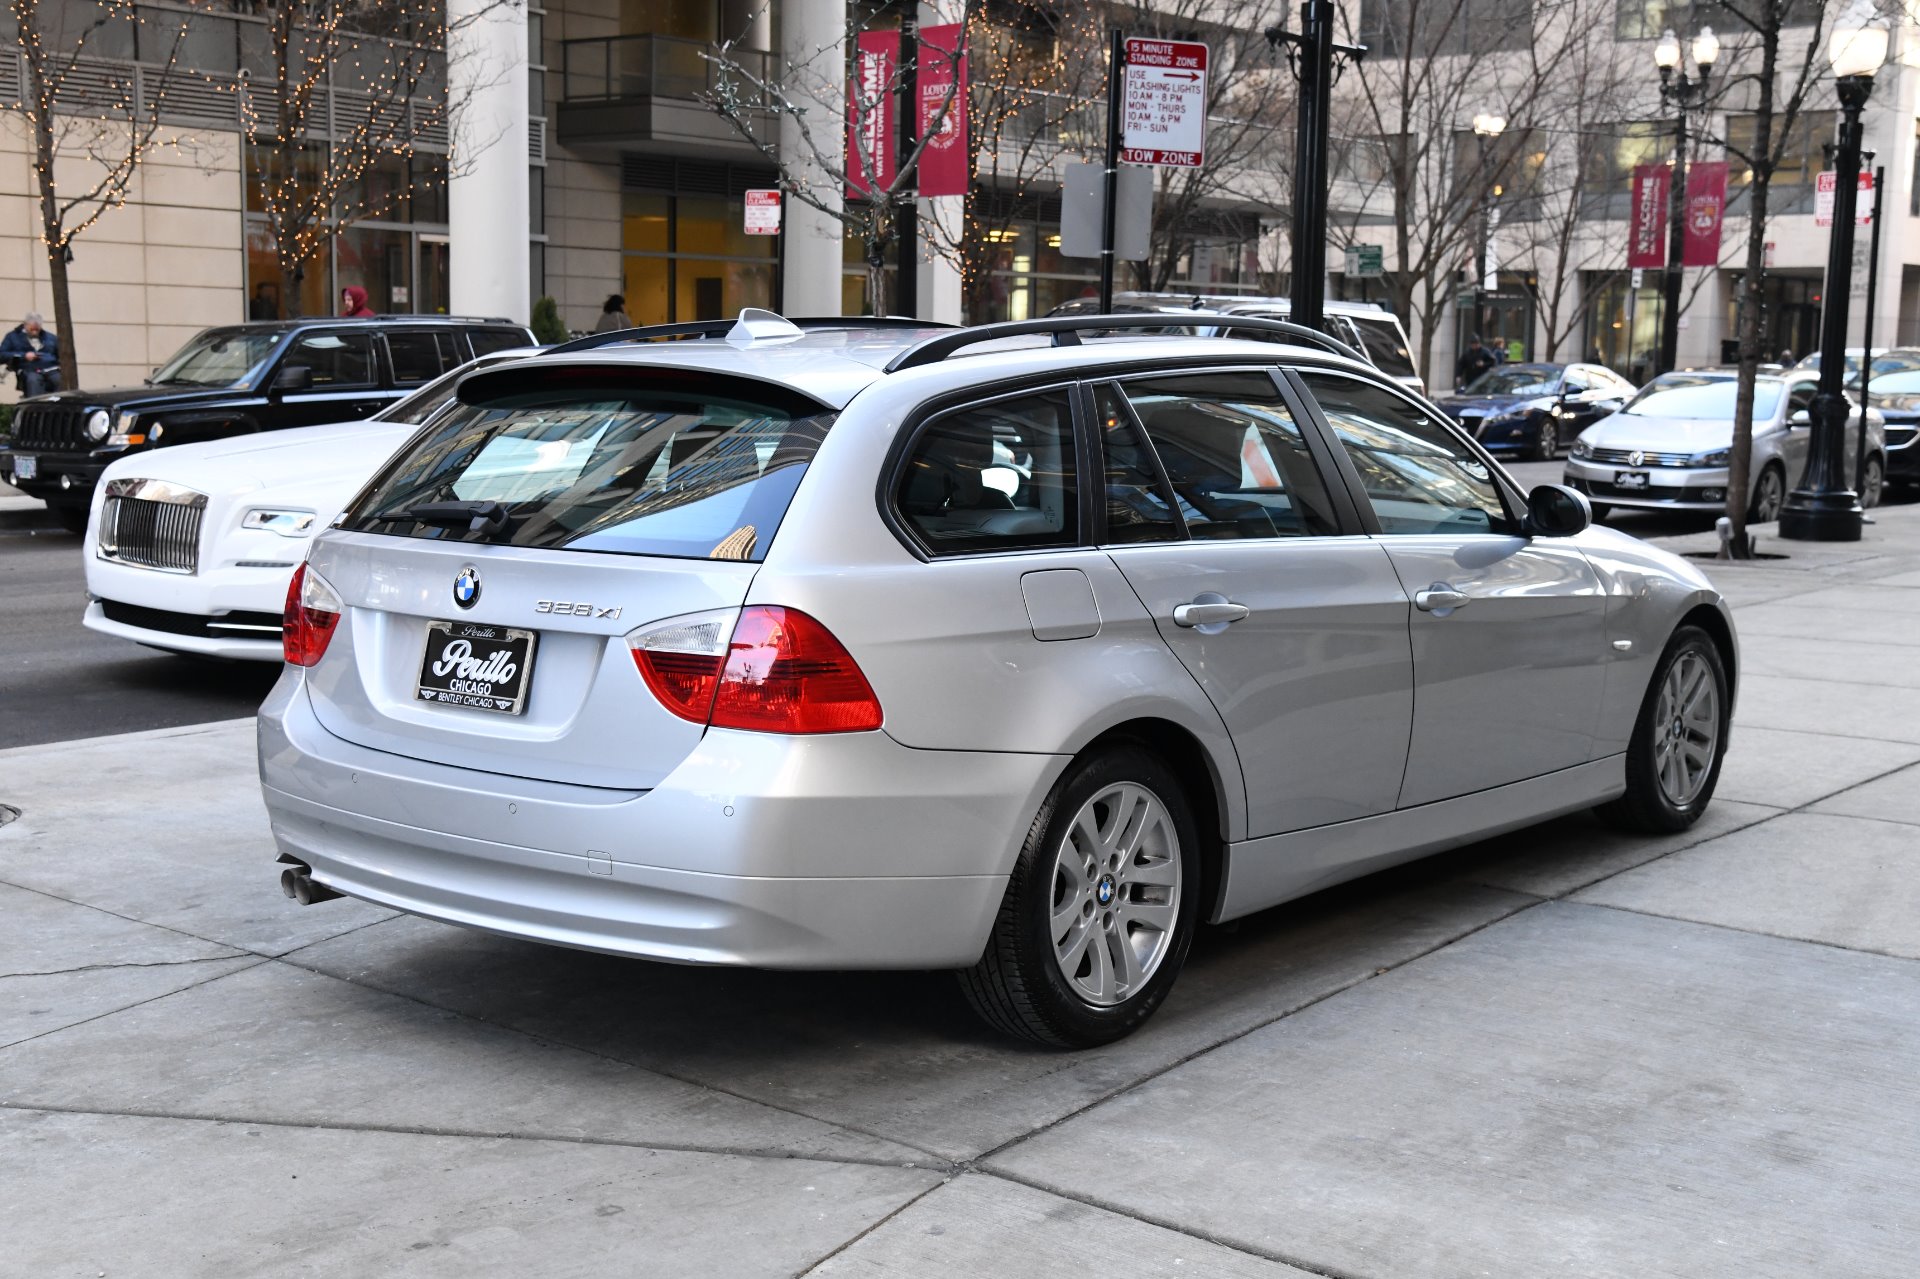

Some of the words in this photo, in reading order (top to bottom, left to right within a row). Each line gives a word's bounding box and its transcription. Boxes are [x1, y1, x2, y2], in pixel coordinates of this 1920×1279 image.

[1130, 42, 1139, 52] 15
[1142, 43, 1173, 55] MINUTE
[1130, 54, 1171, 66] STANDING
[1176, 57, 1198, 68] ZONE
[878, 53, 887, 96] AMPUS
[1129, 70, 1146, 79] USE
[923, 82, 960, 96] LOYO
[1129, 81, 1170, 92] FLASHING
[1172, 84, 1201, 94] LIGHTS
[1128, 91, 1138, 99] 10
[1140, 92, 1152, 100] AM
[1161, 93, 1167, 102] 8
[1170, 94, 1182, 102] PM
[1128, 102, 1147, 110] MON
[1158, 103, 1186, 113] THURS
[861, 53, 878, 178] ELCOME
[877, 97, 885, 139] TOWER
[1128, 112, 1137, 120] 10
[1138, 112, 1151, 120] AM
[1160, 114, 1166, 122] 6
[1168, 115, 1181, 123] PM
[1127, 122, 1141, 131] FRI
[1150, 124, 1168, 133] SUN
[875, 142, 884, 178] WATER
[1126, 149, 1154, 162] TOW
[1160, 152, 1196, 165] ZONE
[534, 600, 623, 620] 328xi
[461, 625, 496, 638] Perillo
[432, 639, 517, 685] Perillo
[449, 678, 492, 695] CHICAGO
[438, 692, 463, 704] BENTLEY
[464, 695, 493, 708] CHICAGO
